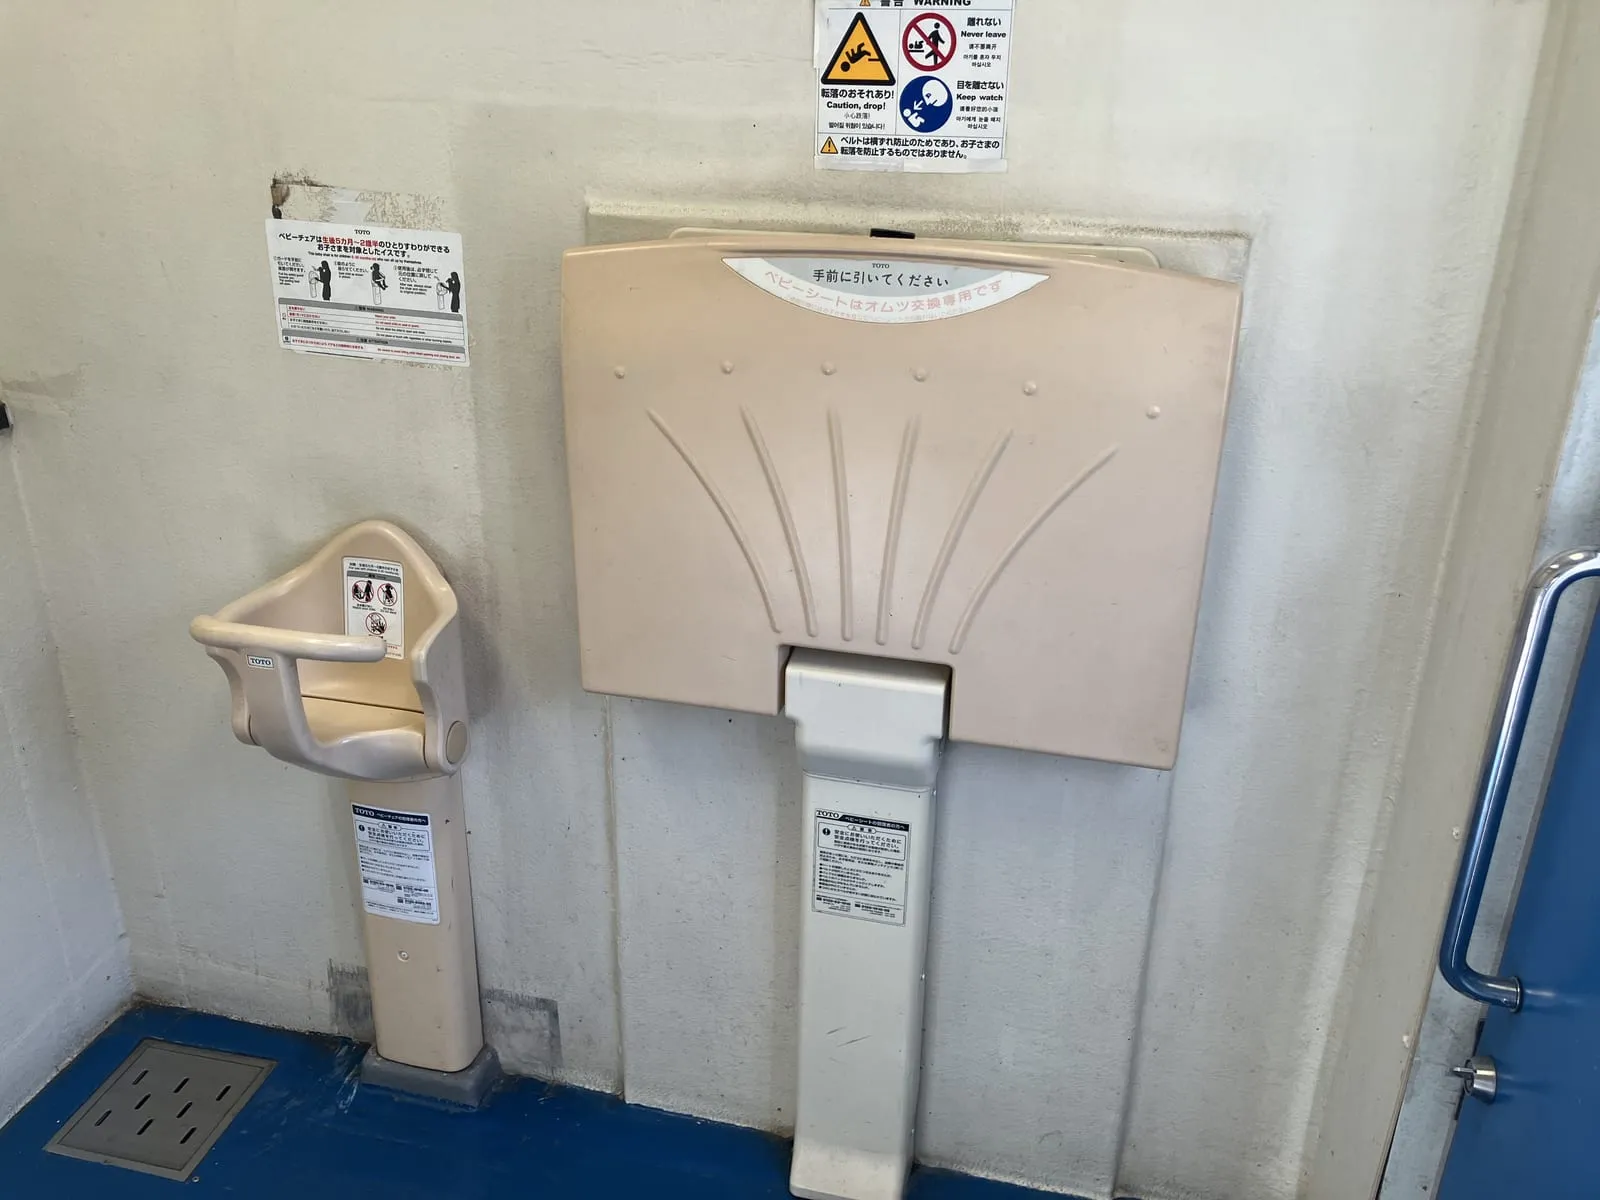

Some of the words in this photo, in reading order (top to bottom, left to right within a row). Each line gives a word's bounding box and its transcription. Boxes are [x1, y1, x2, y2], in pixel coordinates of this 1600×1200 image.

[967, 17, 1002, 27] 離れない
[961, 30, 984, 38] Never
[957, 80, 1004, 90] 目を離さない
[956, 93, 977, 102] Keep
[826, 101, 862, 110] Caution,
[863, 102, 886, 111] drop!
[840, 147, 967, 160] 転落を防止するものではありません。
[812, 268, 949, 288] 手前に引いてください
[765, 270, 1003, 313] ベビーシートはオムツ交換専用です
[354, 807, 375, 817] TOTO
[816, 810, 840, 819] TOTO
